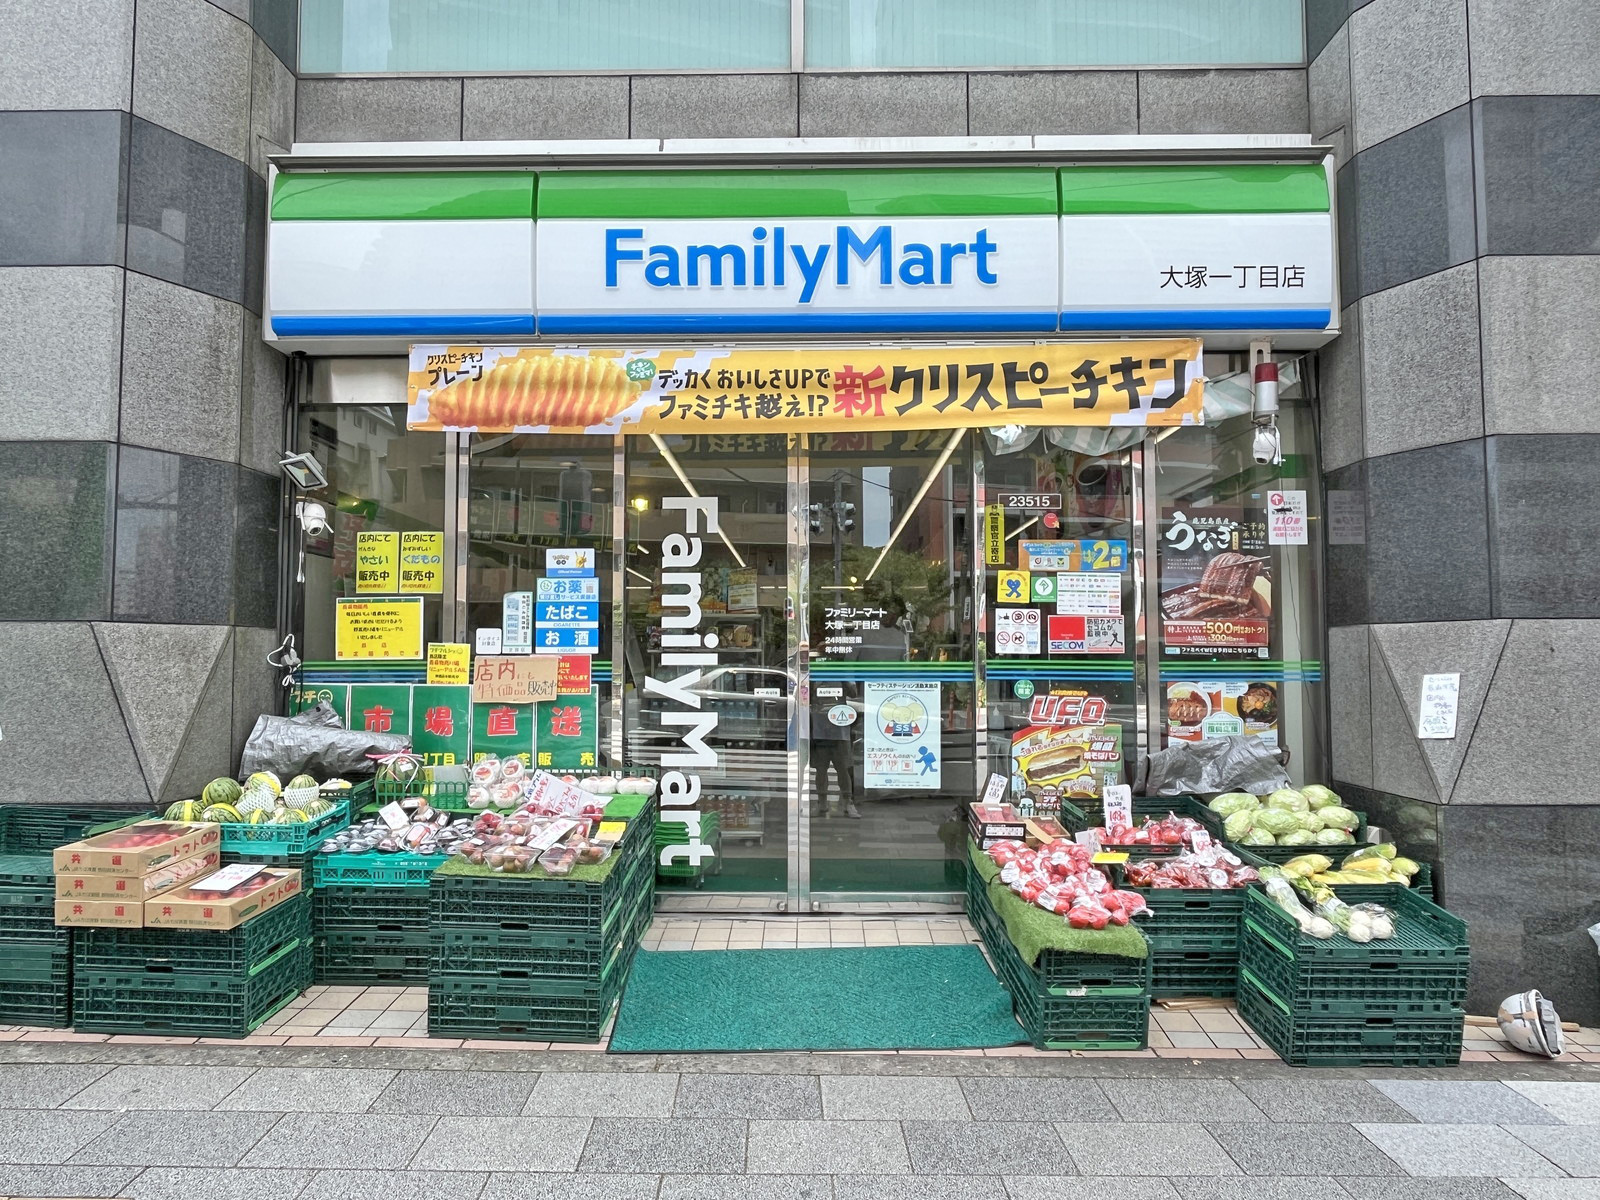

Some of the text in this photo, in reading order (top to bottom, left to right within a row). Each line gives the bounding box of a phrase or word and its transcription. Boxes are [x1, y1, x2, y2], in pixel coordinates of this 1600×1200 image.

[604, 225, 998, 304] FamilyMart
[1160, 265, 1306, 289] 大塚一丁目店
[427, 352, 483, 365] クリスピーチキン
[428, 365, 483, 386] プレーン
[659, 393, 830, 420] ファミチキ越え!?
[1009, 496, 1050, 507] 23515
[1165, 510, 1238, 551] うなぎ
[358, 533, 391, 543] 店内にて
[403, 533, 436, 543] 店内にて
[360, 555, 389, 565] やさい
[403, 555, 441, 564] くだもの
[358, 570, 390, 581] 販売中
[402, 570, 435, 581] 販売中
[553, 580, 582, 593] お薬
[546, 604, 589, 620] たばこ
[824, 607, 888, 618] ファミリーマート
[824, 620, 880, 630] 大塚一丁目店
[545, 630, 589, 645] お酒
[824, 636, 863, 644] 24時間営業
[1051, 641, 1084, 650] SECOM
[644, 496, 719, 866] FamilyMart
[896, 724, 910, 732] SS
[173, 838, 200, 856] トマト
[260, 887, 285, 908] トマト
